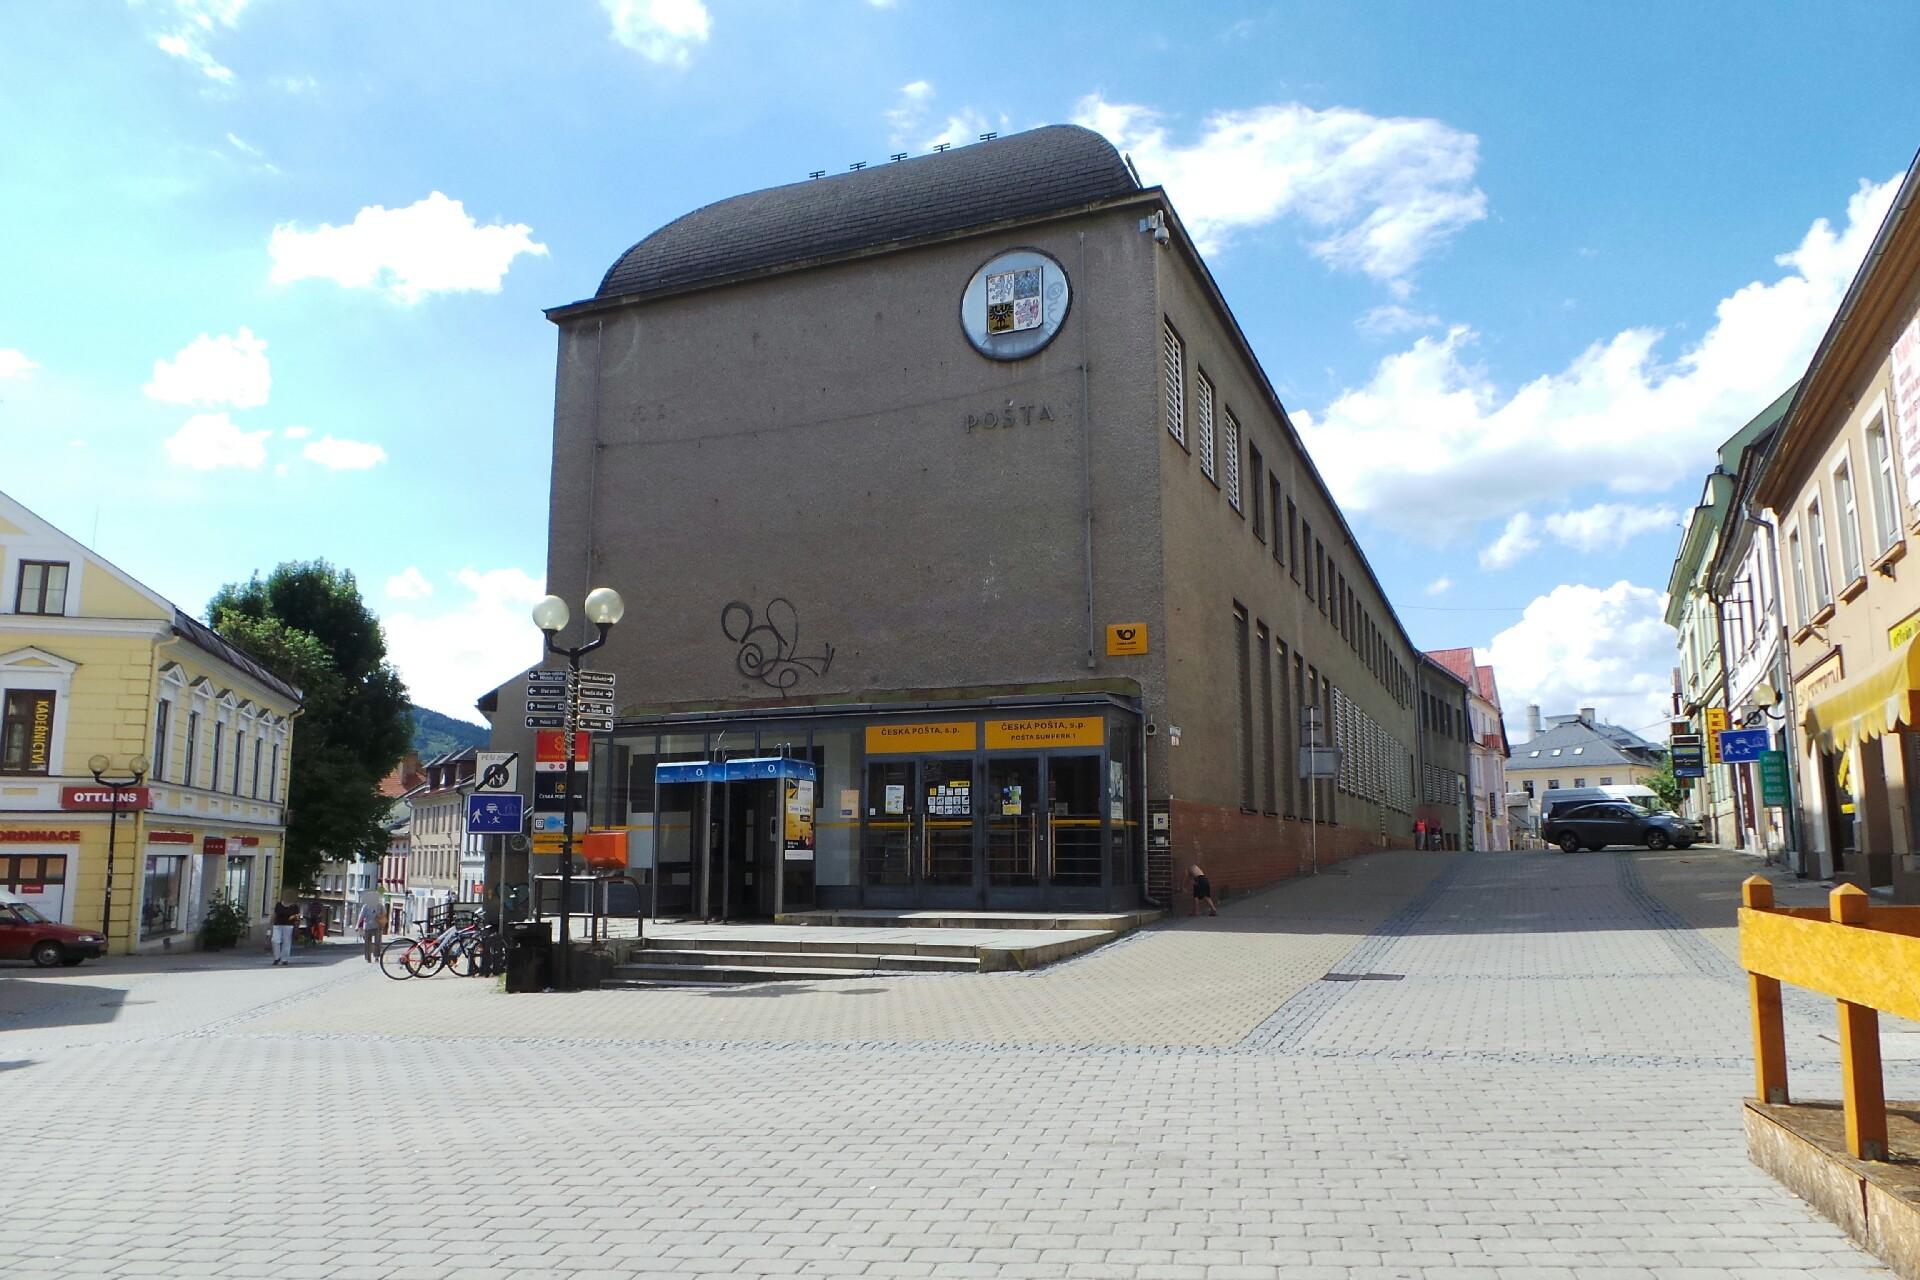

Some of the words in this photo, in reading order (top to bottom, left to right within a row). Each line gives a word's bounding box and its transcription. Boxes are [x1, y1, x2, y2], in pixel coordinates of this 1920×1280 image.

[966, 400, 1055, 435] POŠTA
[1001, 721, 1032, 731] ČESKÁ
[881, 727, 910, 736] ČESKÁ
